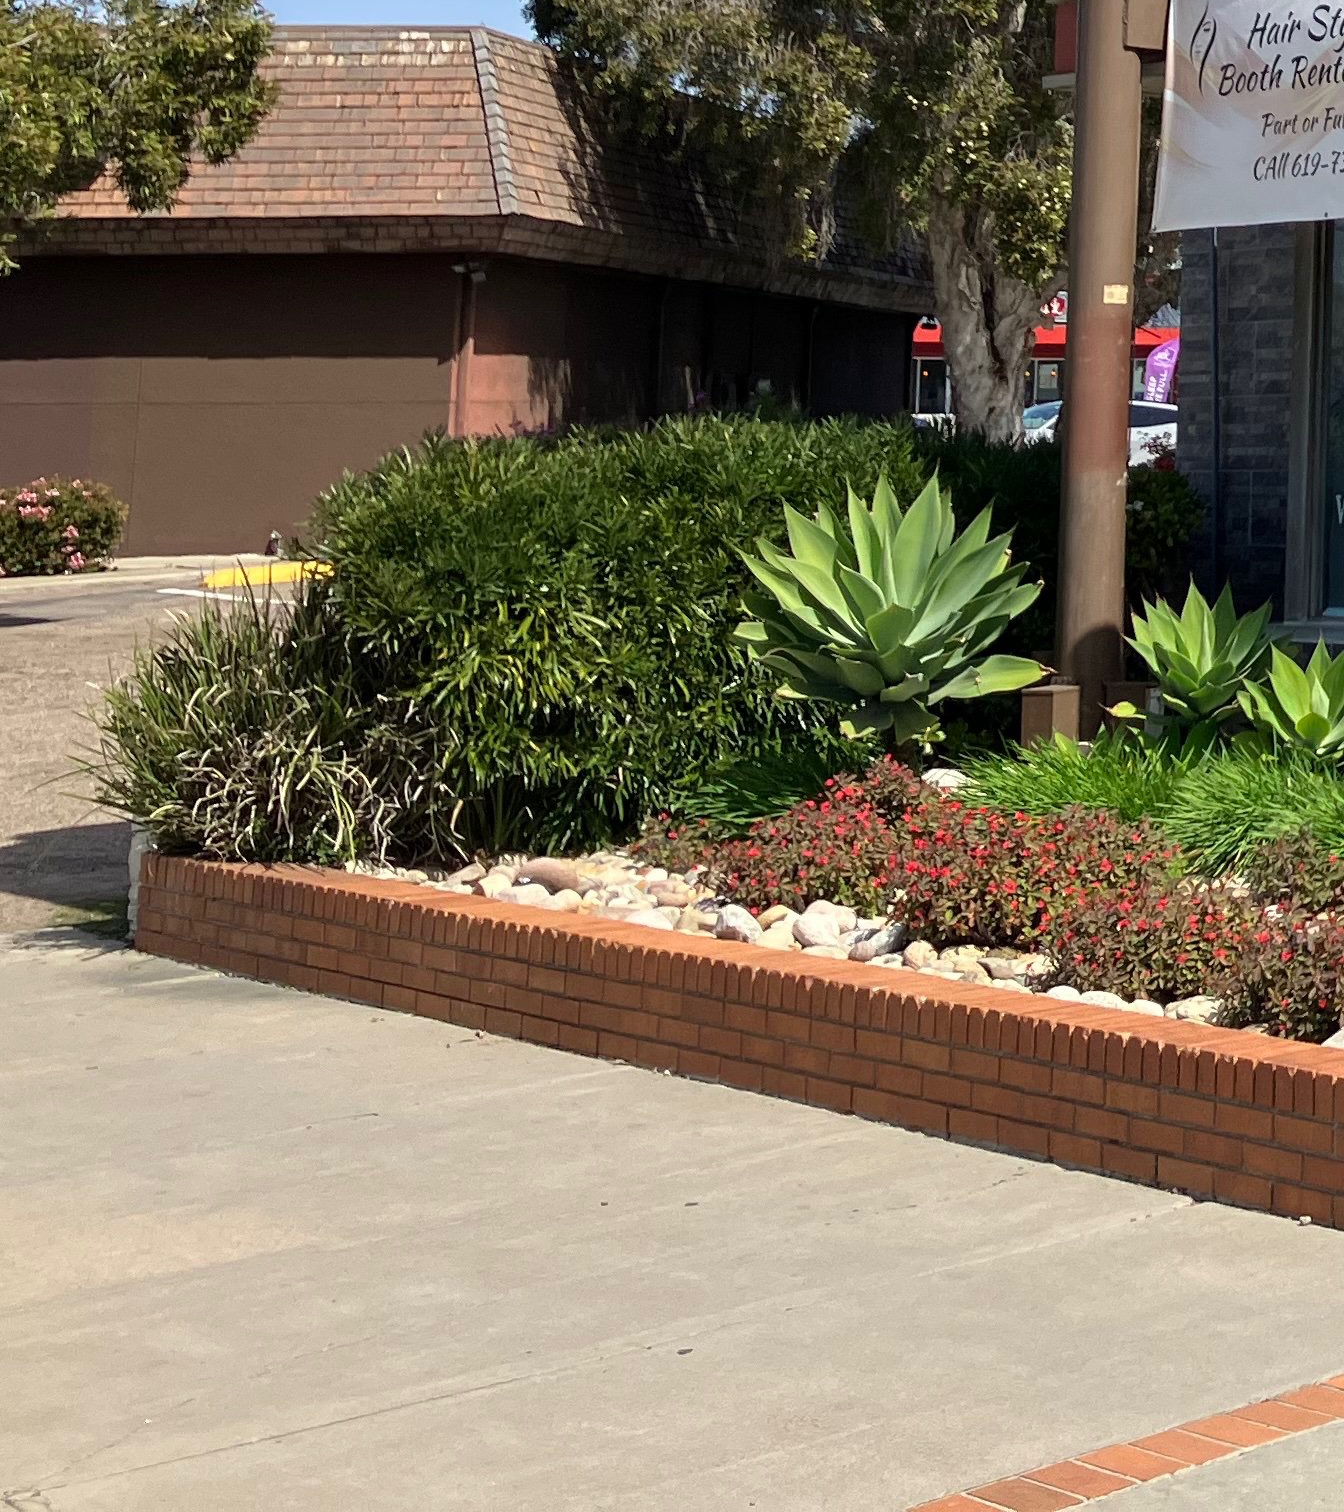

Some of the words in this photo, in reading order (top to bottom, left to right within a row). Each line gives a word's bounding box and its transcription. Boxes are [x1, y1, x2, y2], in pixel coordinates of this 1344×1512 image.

[1247, 11, 1301, 50] Hair
[1219, 53, 1283, 96] Booth
[1261, 113, 1298, 137] Part
[1302, 116, 1318, 132] or
